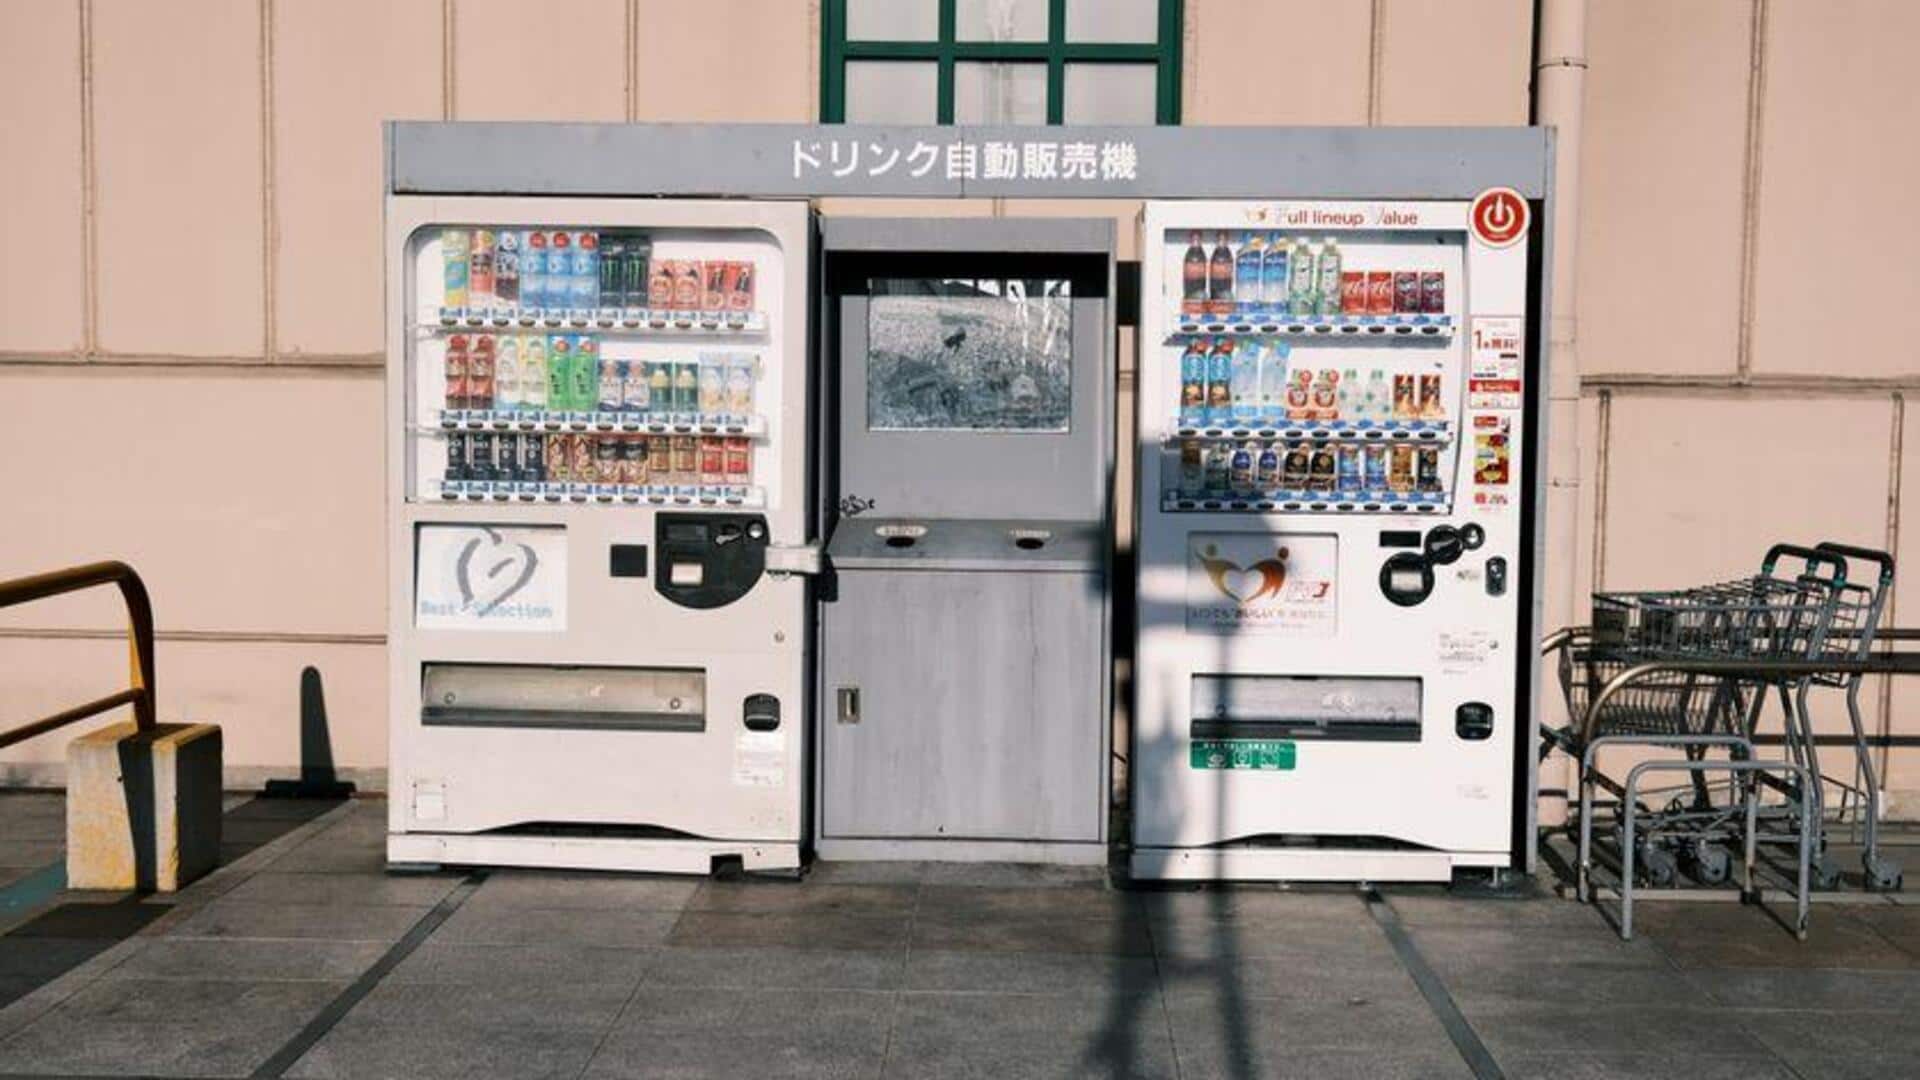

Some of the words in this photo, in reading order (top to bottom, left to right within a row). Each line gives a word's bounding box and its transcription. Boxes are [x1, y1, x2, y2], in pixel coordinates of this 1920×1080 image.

[792, 140, 1137, 181] ドリンク自動販売機
[1313, 210, 1365, 227] lineup
